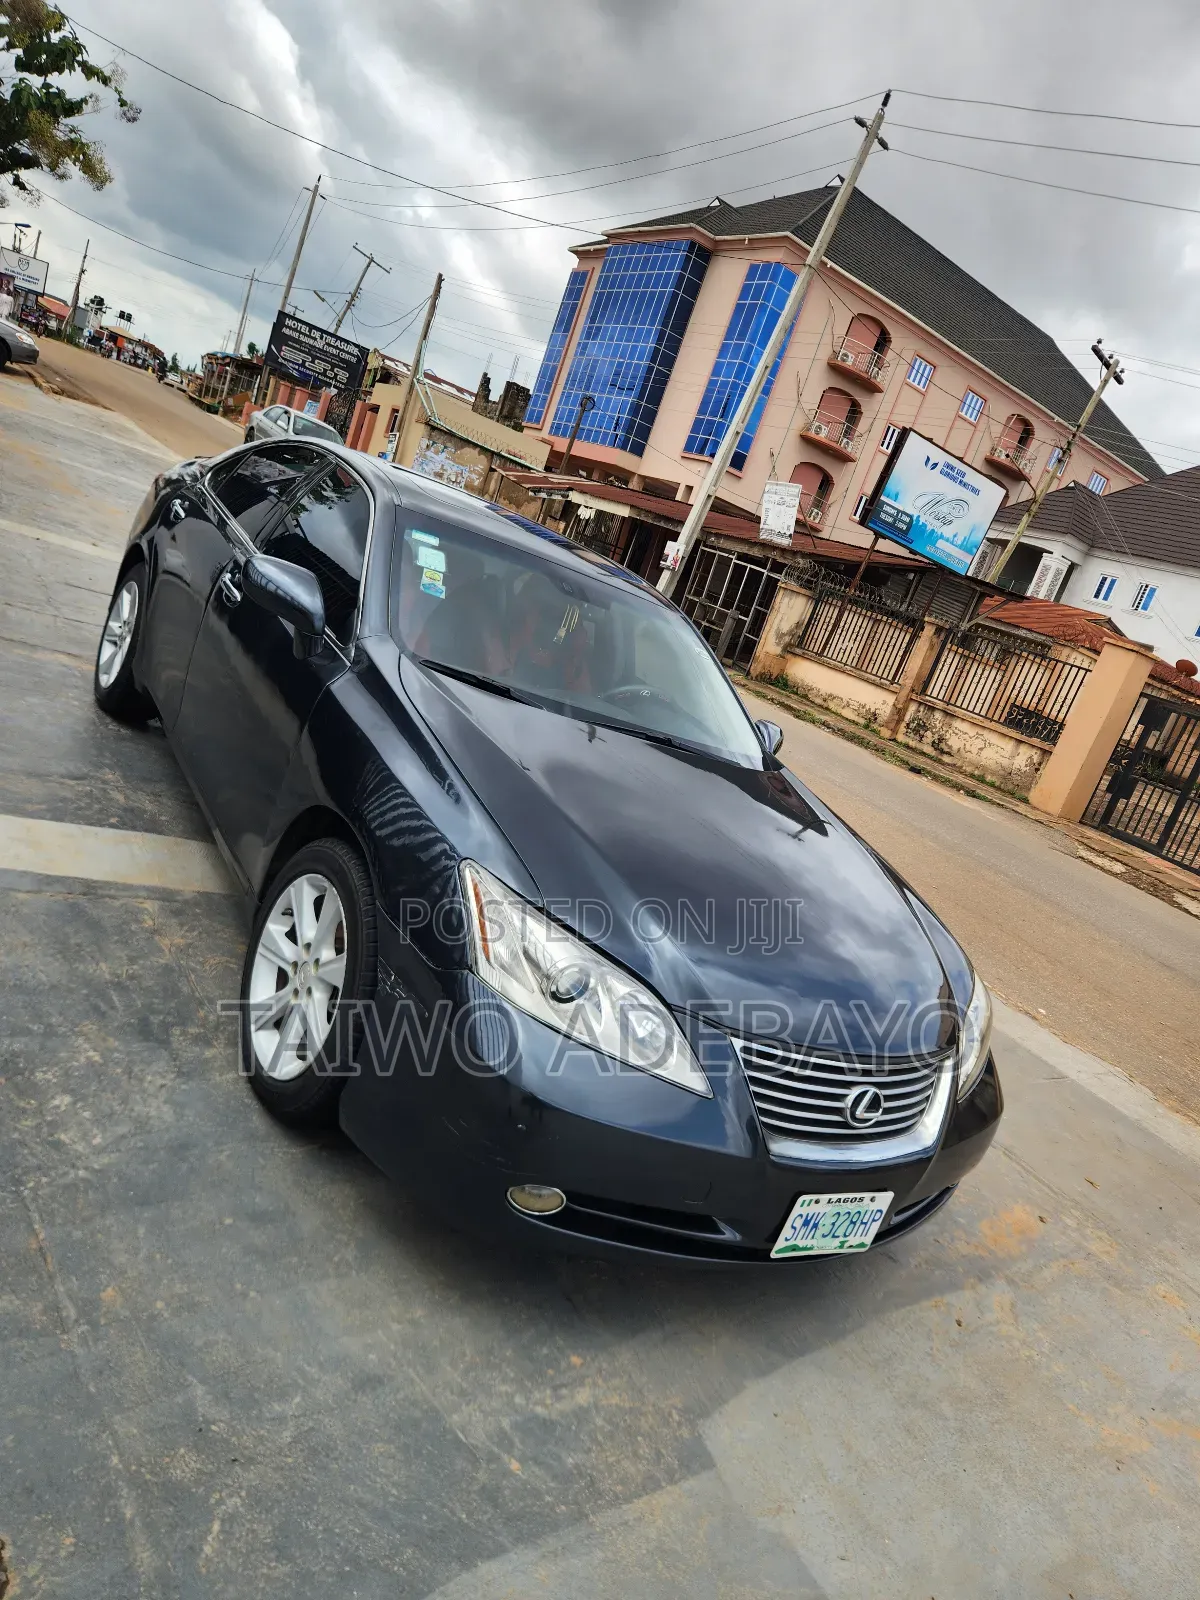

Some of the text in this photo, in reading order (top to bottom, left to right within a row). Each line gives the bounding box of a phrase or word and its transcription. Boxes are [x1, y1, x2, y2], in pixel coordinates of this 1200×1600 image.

[281, 327, 299, 339] ABAKE
[324, 344, 339, 356] EVENT
[340, 349, 358, 363] CENTRE
[285, 318, 310, 334] HOTEL
[311, 329, 320, 340] DE
[322, 333, 359, 355] TREASURE
[299, 365, 318, 377] SECURITY
[943, 461, 967, 479] LIVING SEED
[940, 468, 981, 496] GLORIOUS MINISTRIES
[826, 1196, 866, 1204] LAGOS
